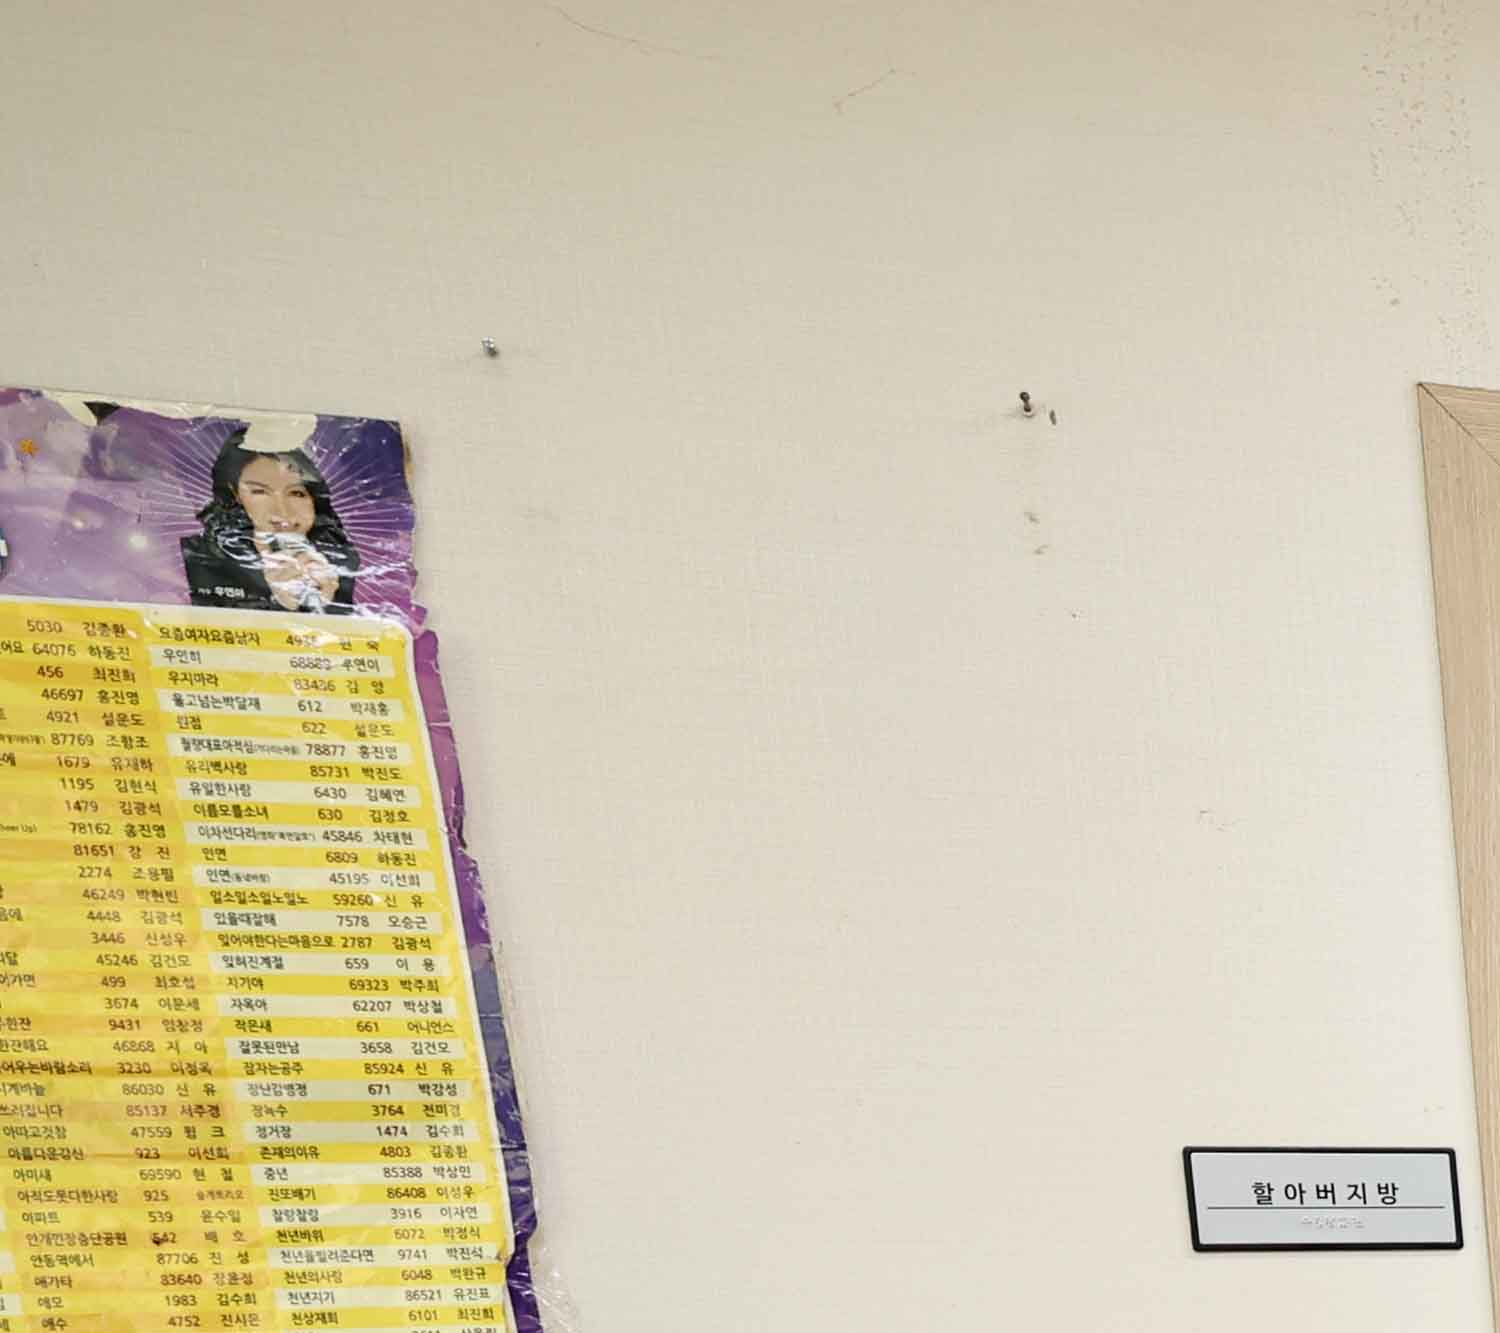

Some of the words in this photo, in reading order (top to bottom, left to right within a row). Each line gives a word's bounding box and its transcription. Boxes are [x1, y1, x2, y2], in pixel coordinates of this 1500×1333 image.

[41, 689, 84, 701] 46697
[298, 700, 323, 712] 612
[309, 764, 350, 778] 85731
[318, 808, 343, 821] 630
[325, 851, 359, 864] 6809
[336, 915, 370, 928] 7578
[341, 935, 372, 949] 2787
[349, 978, 389, 991] 69323
[352, 999, 392, 1012] 62207
[356, 1020, 380, 1033] 661
[360, 1040, 393, 1054] 3658
[364, 1062, 405, 1075] 85924
[368, 1083, 391, 1096] 671
[372, 1104, 405, 1117] 3764
[379, 1145, 412, 1157] 4803
[383, 1166, 423, 1179] 85388
[386, 1187, 426, 1199] 86408
[1251, 1181, 1399, 1206] 할아버지방
[405, 1289, 443, 1302] 86521
